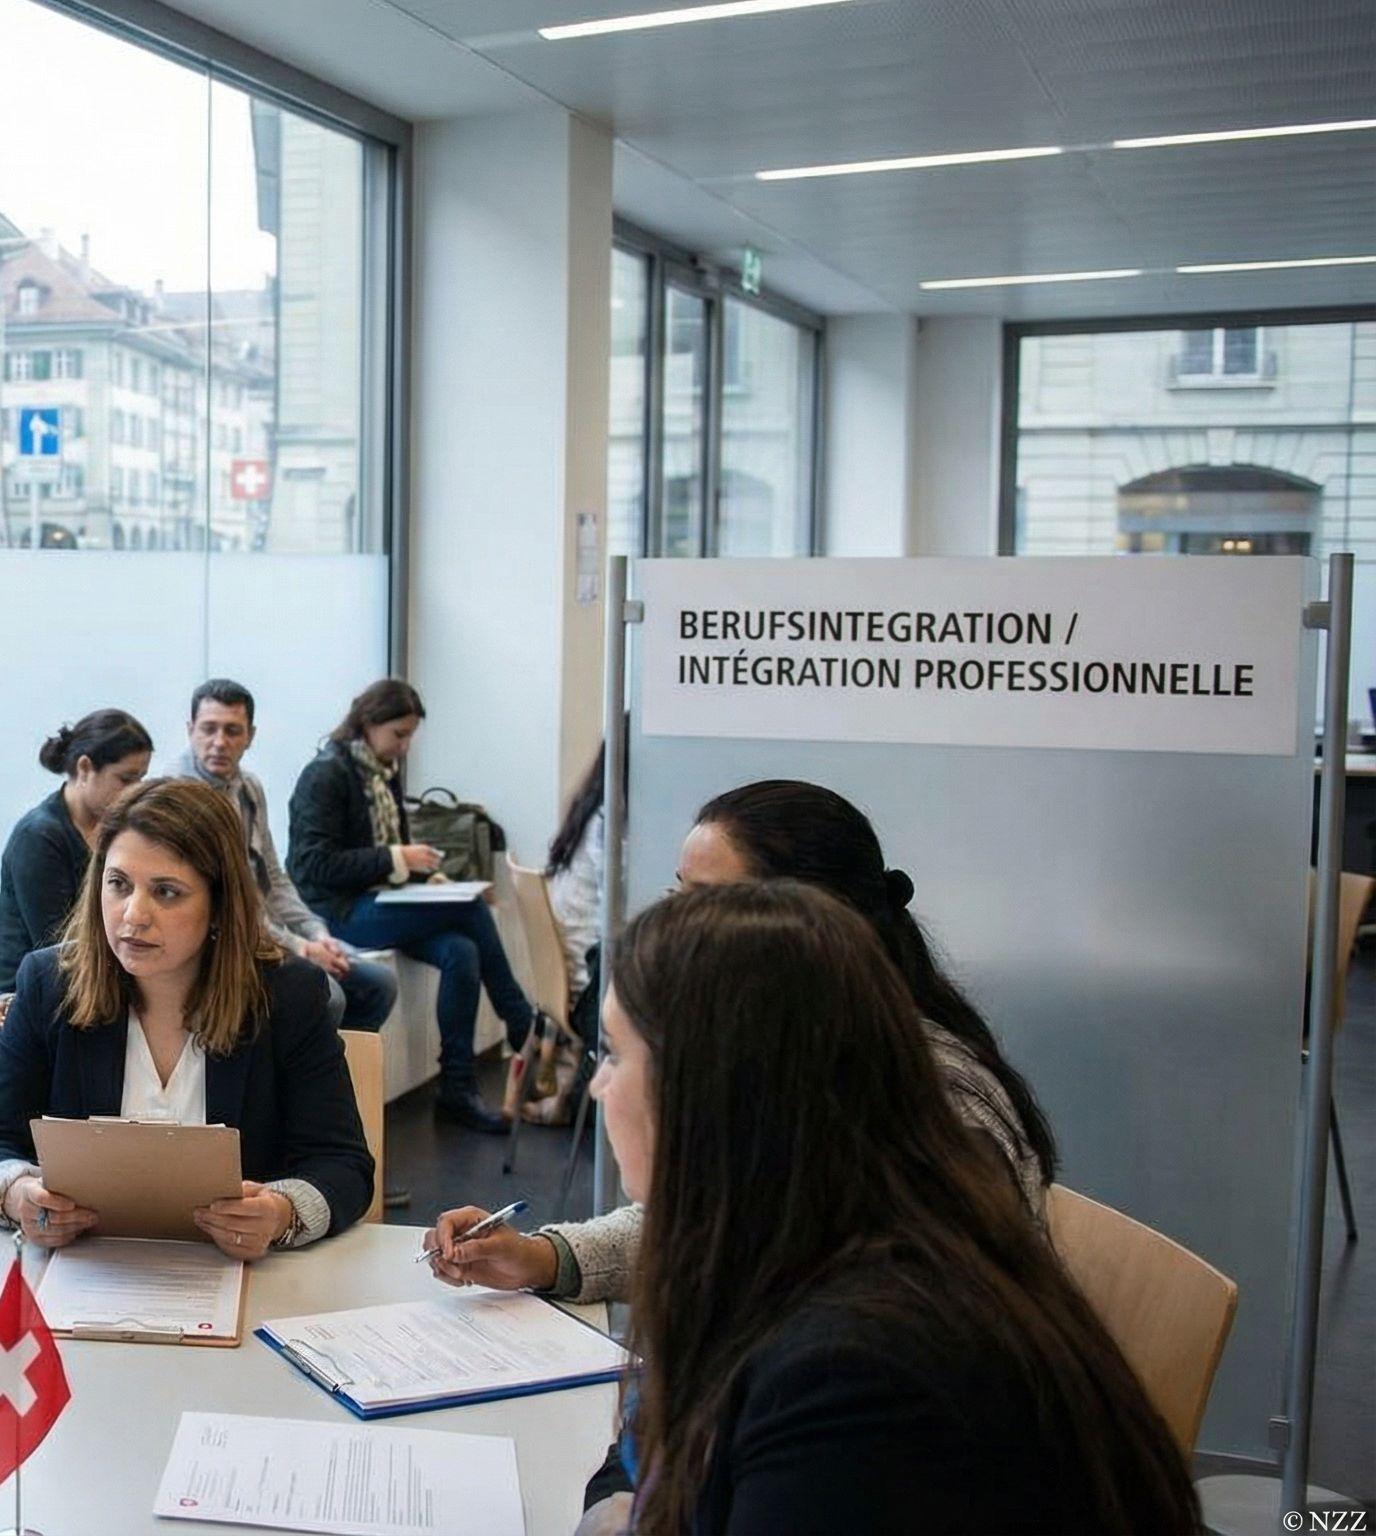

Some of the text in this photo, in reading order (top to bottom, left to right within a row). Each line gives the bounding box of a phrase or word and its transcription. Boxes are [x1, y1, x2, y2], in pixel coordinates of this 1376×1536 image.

[679, 609, 1079, 645] BERUFSINTEGRATION /
[678, 648, 1255, 698] INTÉGRATION PROFESSIONNELLE
